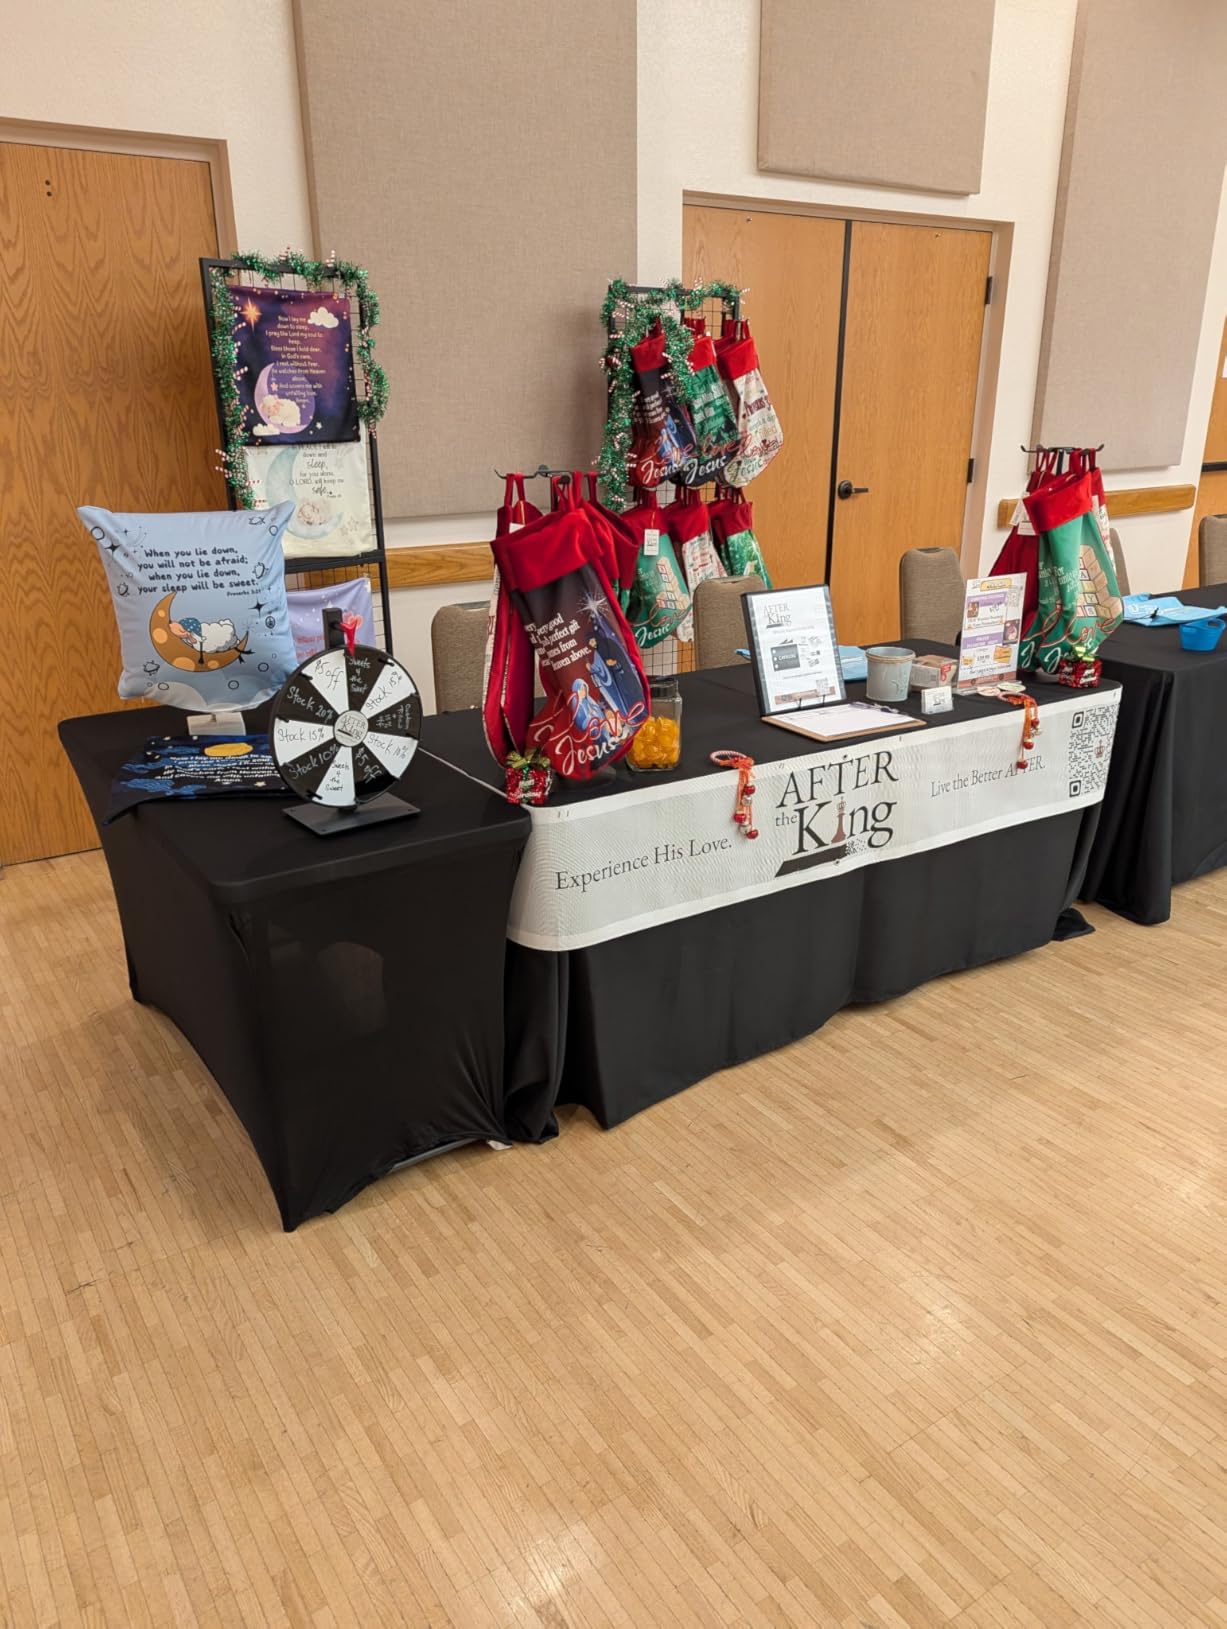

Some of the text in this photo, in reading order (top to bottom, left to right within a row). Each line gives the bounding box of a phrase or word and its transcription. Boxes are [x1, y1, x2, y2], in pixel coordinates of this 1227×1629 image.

[641, 460, 681, 484] Jesus
[681, 456, 727, 484] Jesus
[144, 549, 171, 558] When
[174, 550, 191, 559] you
[194, 547, 208, 556] lie
[137, 555, 249, 572] you will not be afraid;
[148, 572, 172, 581] when
[176, 572, 194, 582] you
[196, 570, 210, 579] lie
[137, 580, 259, 595] your sleep will be sweet.
[763, 602, 790, 618] AFTER
[548, 612, 564, 632] good
[549, 619, 580, 646] perfect gift
[635, 624, 671, 646] Jesus
[558, 638, 578, 652] from
[570, 646, 592, 662] above.
[326, 667, 344, 690] off
[350, 676, 363, 684] the
[287, 686, 333, 726] Stock 20%
[366, 687, 392, 710] Stock
[278, 728, 325, 745] Stock 15%
[367, 734, 392, 752] Stock
[555, 727, 631, 776] Jesus
[288, 756, 318, 780] Stock
[363, 765, 382, 784] off
[775, 750, 898, 809] AFTER
[930, 780, 951, 798] Live
[953, 773, 970, 790] the
[971, 765, 1003, 786] Better
[774, 811, 798, 828] the
[554, 837, 732, 893] Experience His Love.
